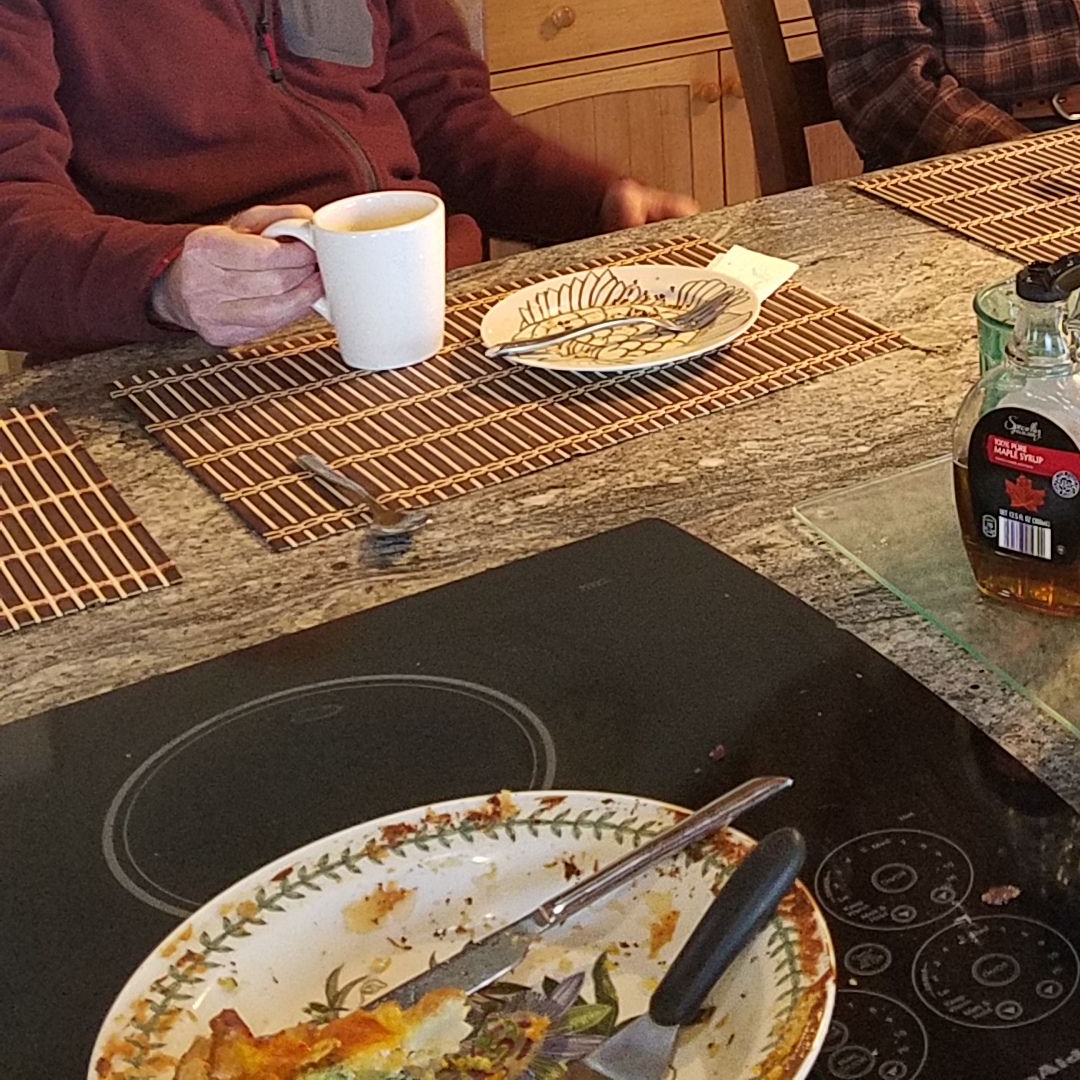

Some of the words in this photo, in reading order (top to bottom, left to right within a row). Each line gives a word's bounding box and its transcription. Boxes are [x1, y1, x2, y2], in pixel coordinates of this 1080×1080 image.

[993, 445, 1018, 460] MAPLE
[1019, 452, 1044, 464] SYRUP
[1010, 441, 1028, 453] PURE
